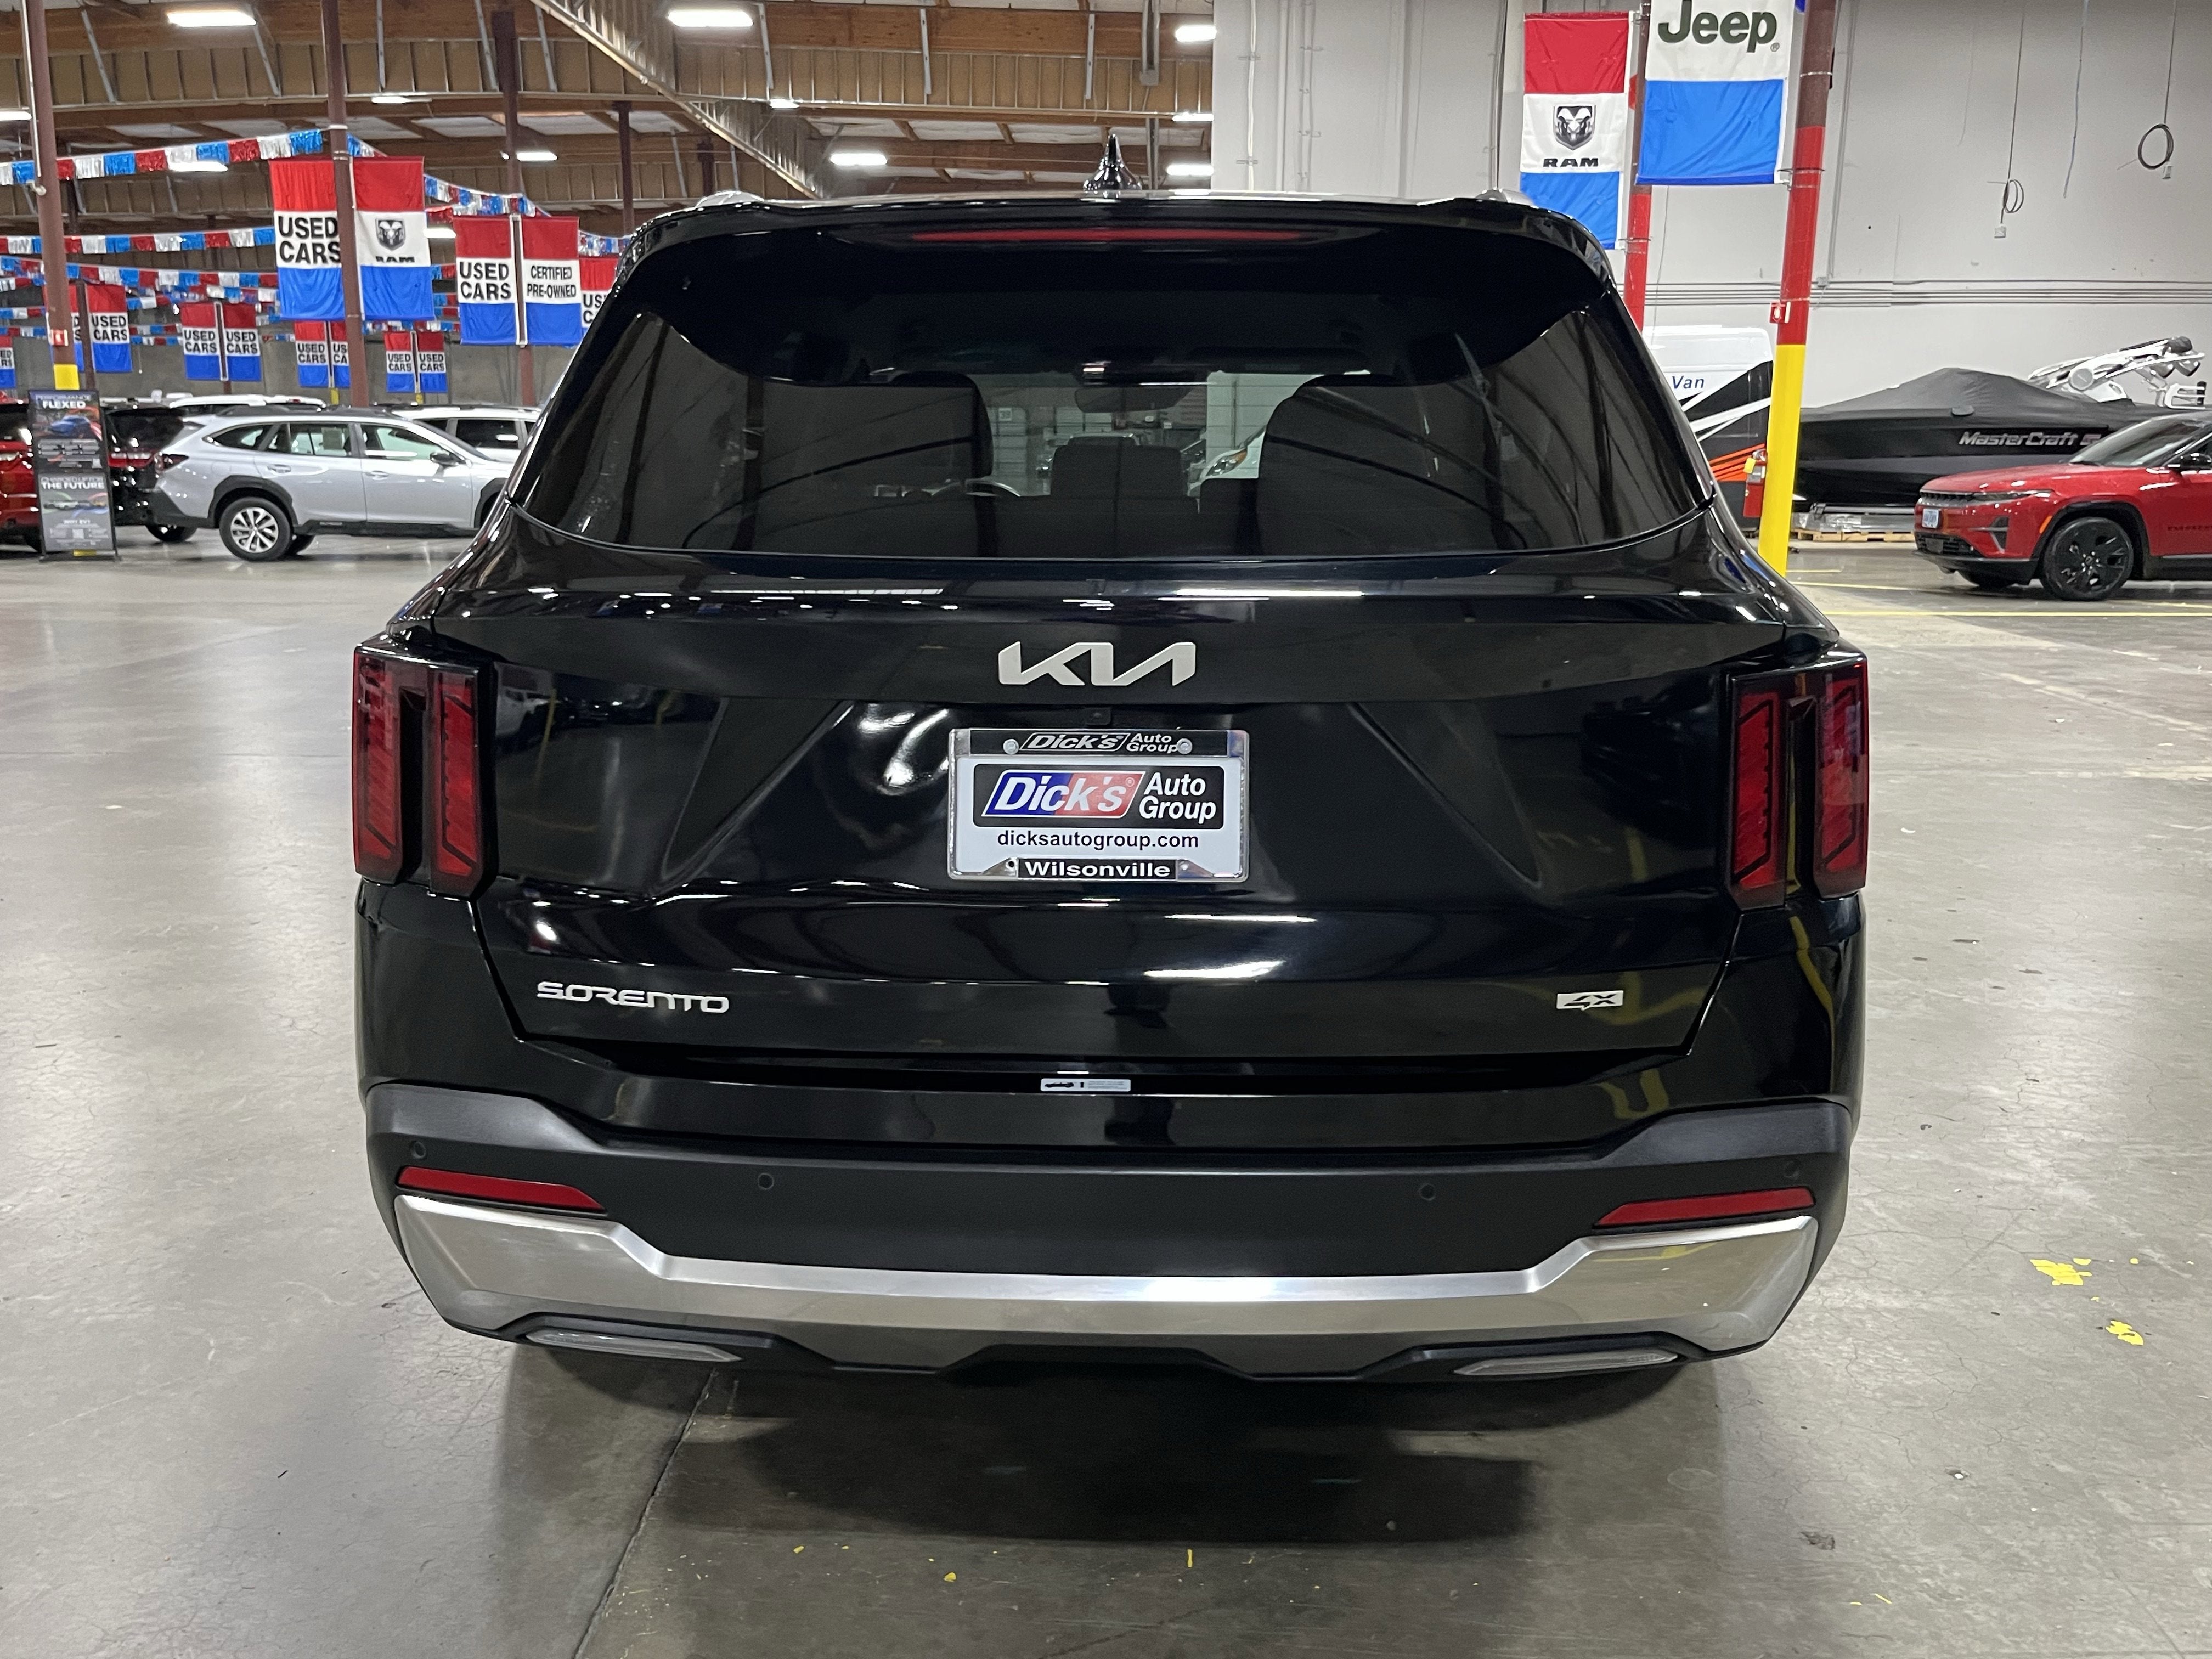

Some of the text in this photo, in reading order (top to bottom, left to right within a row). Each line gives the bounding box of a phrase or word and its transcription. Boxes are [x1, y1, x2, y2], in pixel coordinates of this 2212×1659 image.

[1658, 0, 1777, 53] Jeep
[1543, 157, 1599, 167] RAM
[278, 216, 338, 240] USED
[279, 240, 341, 264] CARS
[459, 262, 509, 280] USED
[531, 266, 572, 280] CERTIFIED
[460, 281, 511, 301] CARS
[527, 283, 577, 298] PRE-OWNED
[583, 294, 606, 309] US
[92, 315, 126, 328] USED
[94, 329, 127, 341] CARS
[184, 330, 215, 342] USED
[226, 331, 256, 342] USED
[0, 349, 12, 358] ED
[185, 342, 217, 353] CARS
[227, 342, 258, 354] CARS
[297, 343, 325, 353] USED
[333, 343, 348, 353] US
[298, 354, 326, 364] CARS
[333, 354, 348, 364] CA
[388, 353, 411, 362] USED
[419, 353, 444, 362] USED
[388, 363, 412, 371] CARS
[420, 363, 445, 371] CARS
[1672, 375, 1705, 389] Van
[43, 400, 86, 409] FLEXED
[1959, 431, 2078, 446] MasterCraft
[998, 641, 1197, 686] KIA
[1027, 733, 1119, 749] Dick's
[1130, 733, 1172, 743] Auto
[1126, 742, 1178, 754] Group
[1145, 772, 1206, 796] Auto
[994, 775, 1126, 812] Dick's
[1139, 797, 1216, 824] Group
[997, 830, 1199, 850] dicksautogroup.com
[1025, 860, 1171, 878] Wilsonville
[537, 981, 730, 1013] SORENTO
